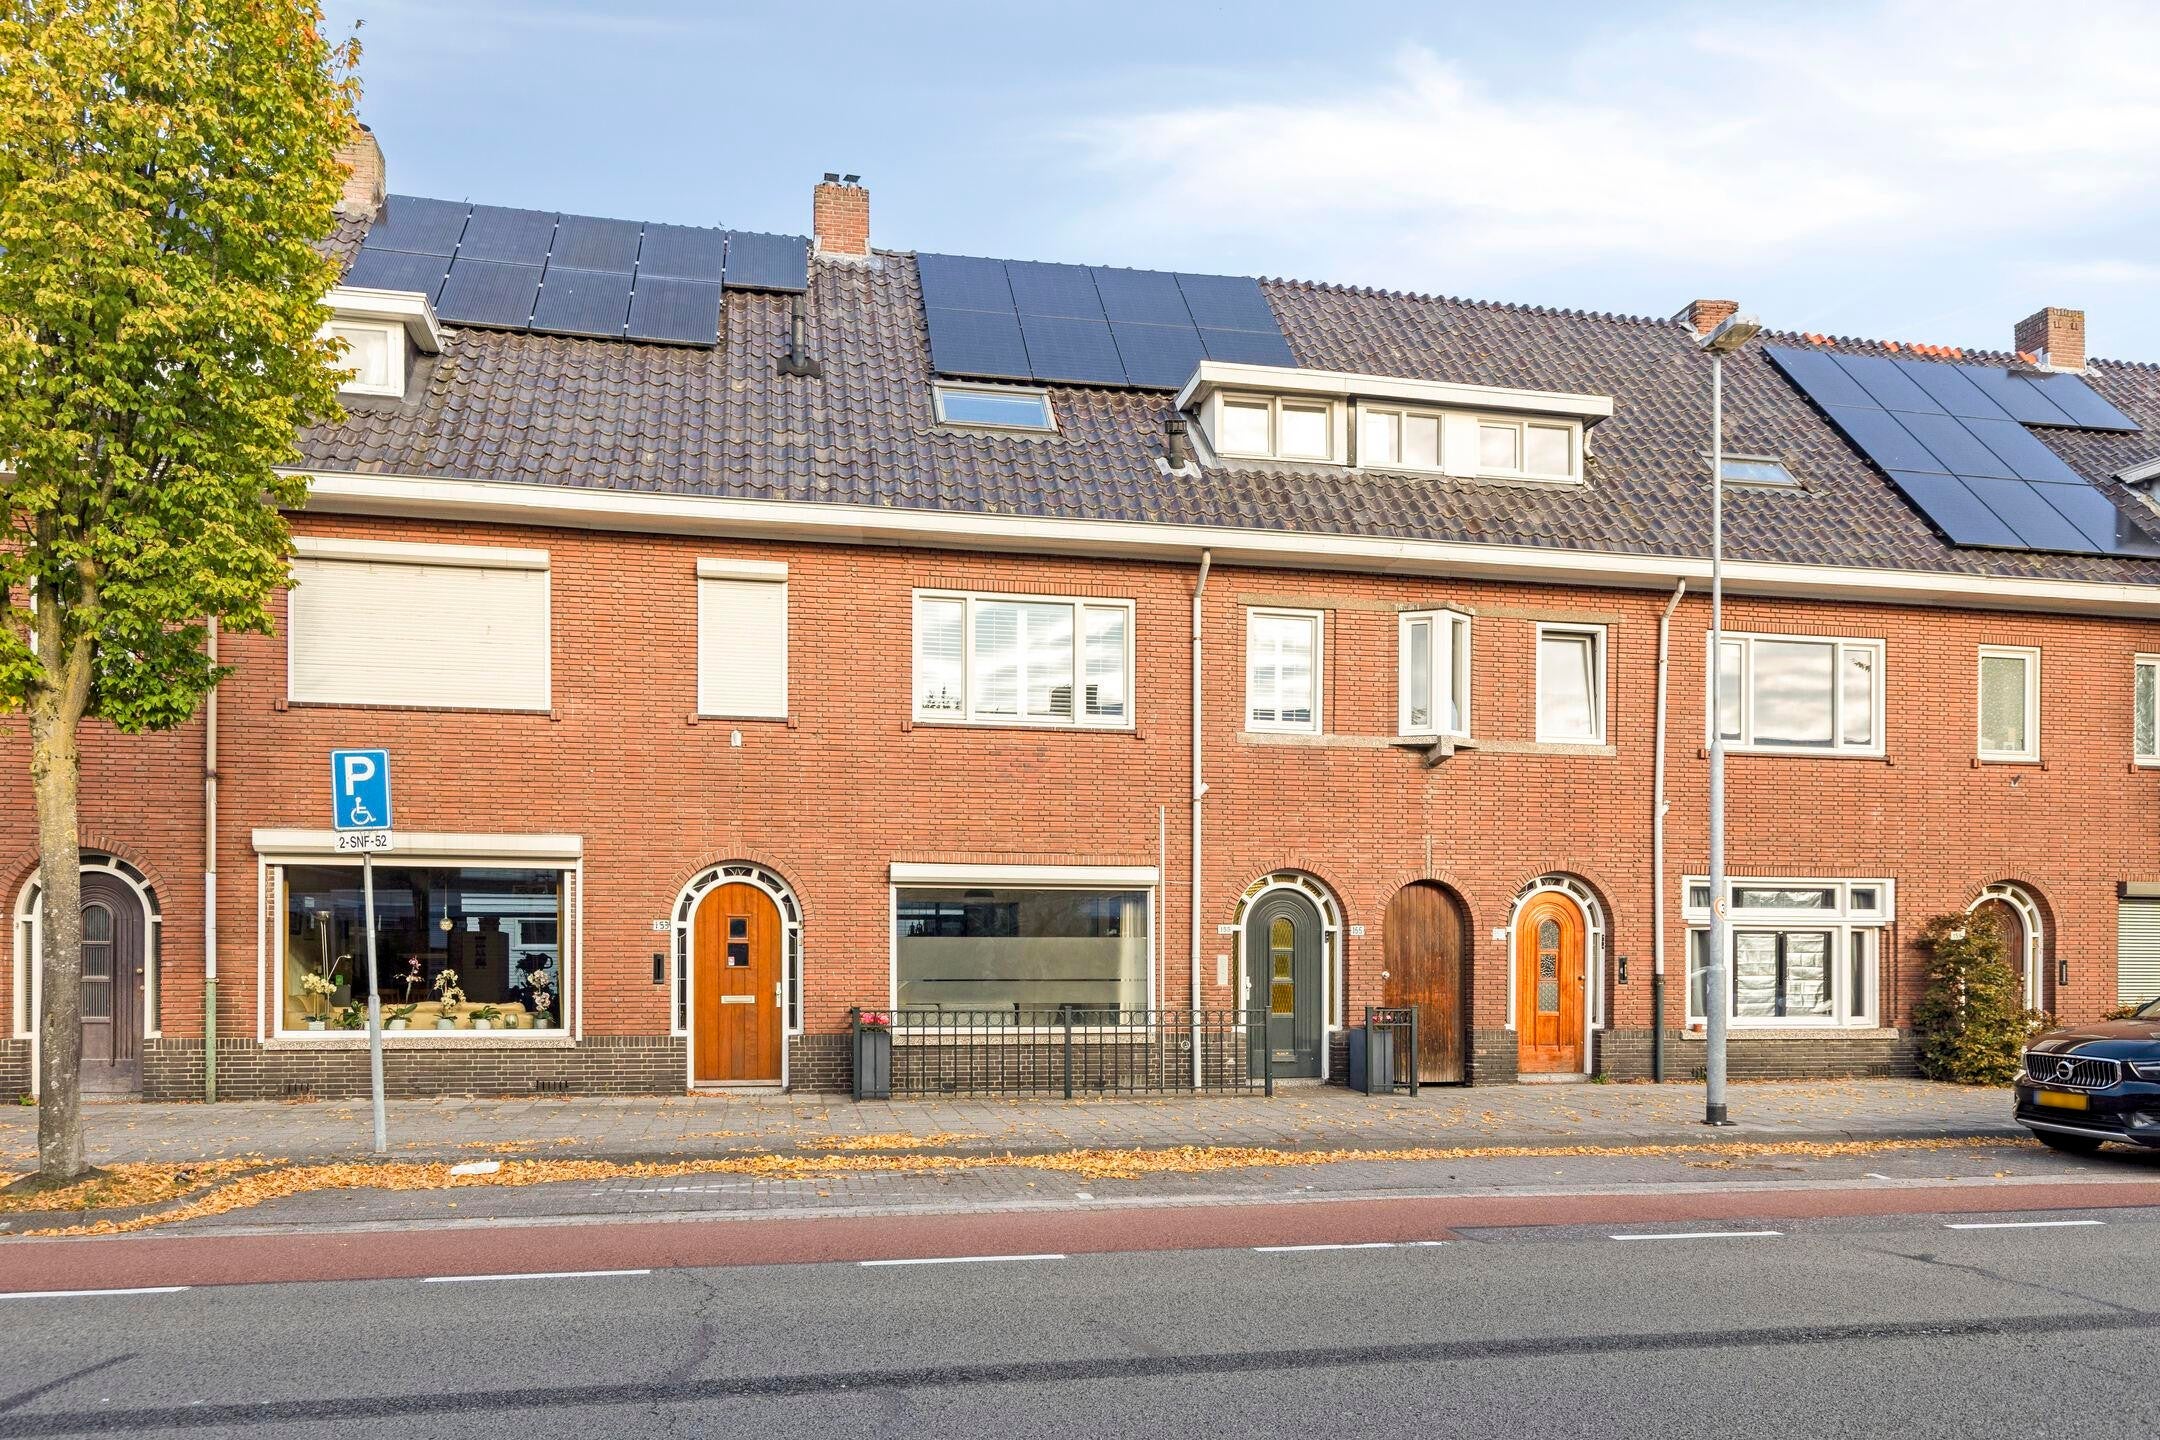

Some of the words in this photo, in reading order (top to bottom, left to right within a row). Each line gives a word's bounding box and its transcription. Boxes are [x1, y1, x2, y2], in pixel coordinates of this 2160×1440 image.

[344, 756, 376, 796] P
[339, 834, 387, 849] 2-SNF-52
[655, 921, 669, 929] 153
